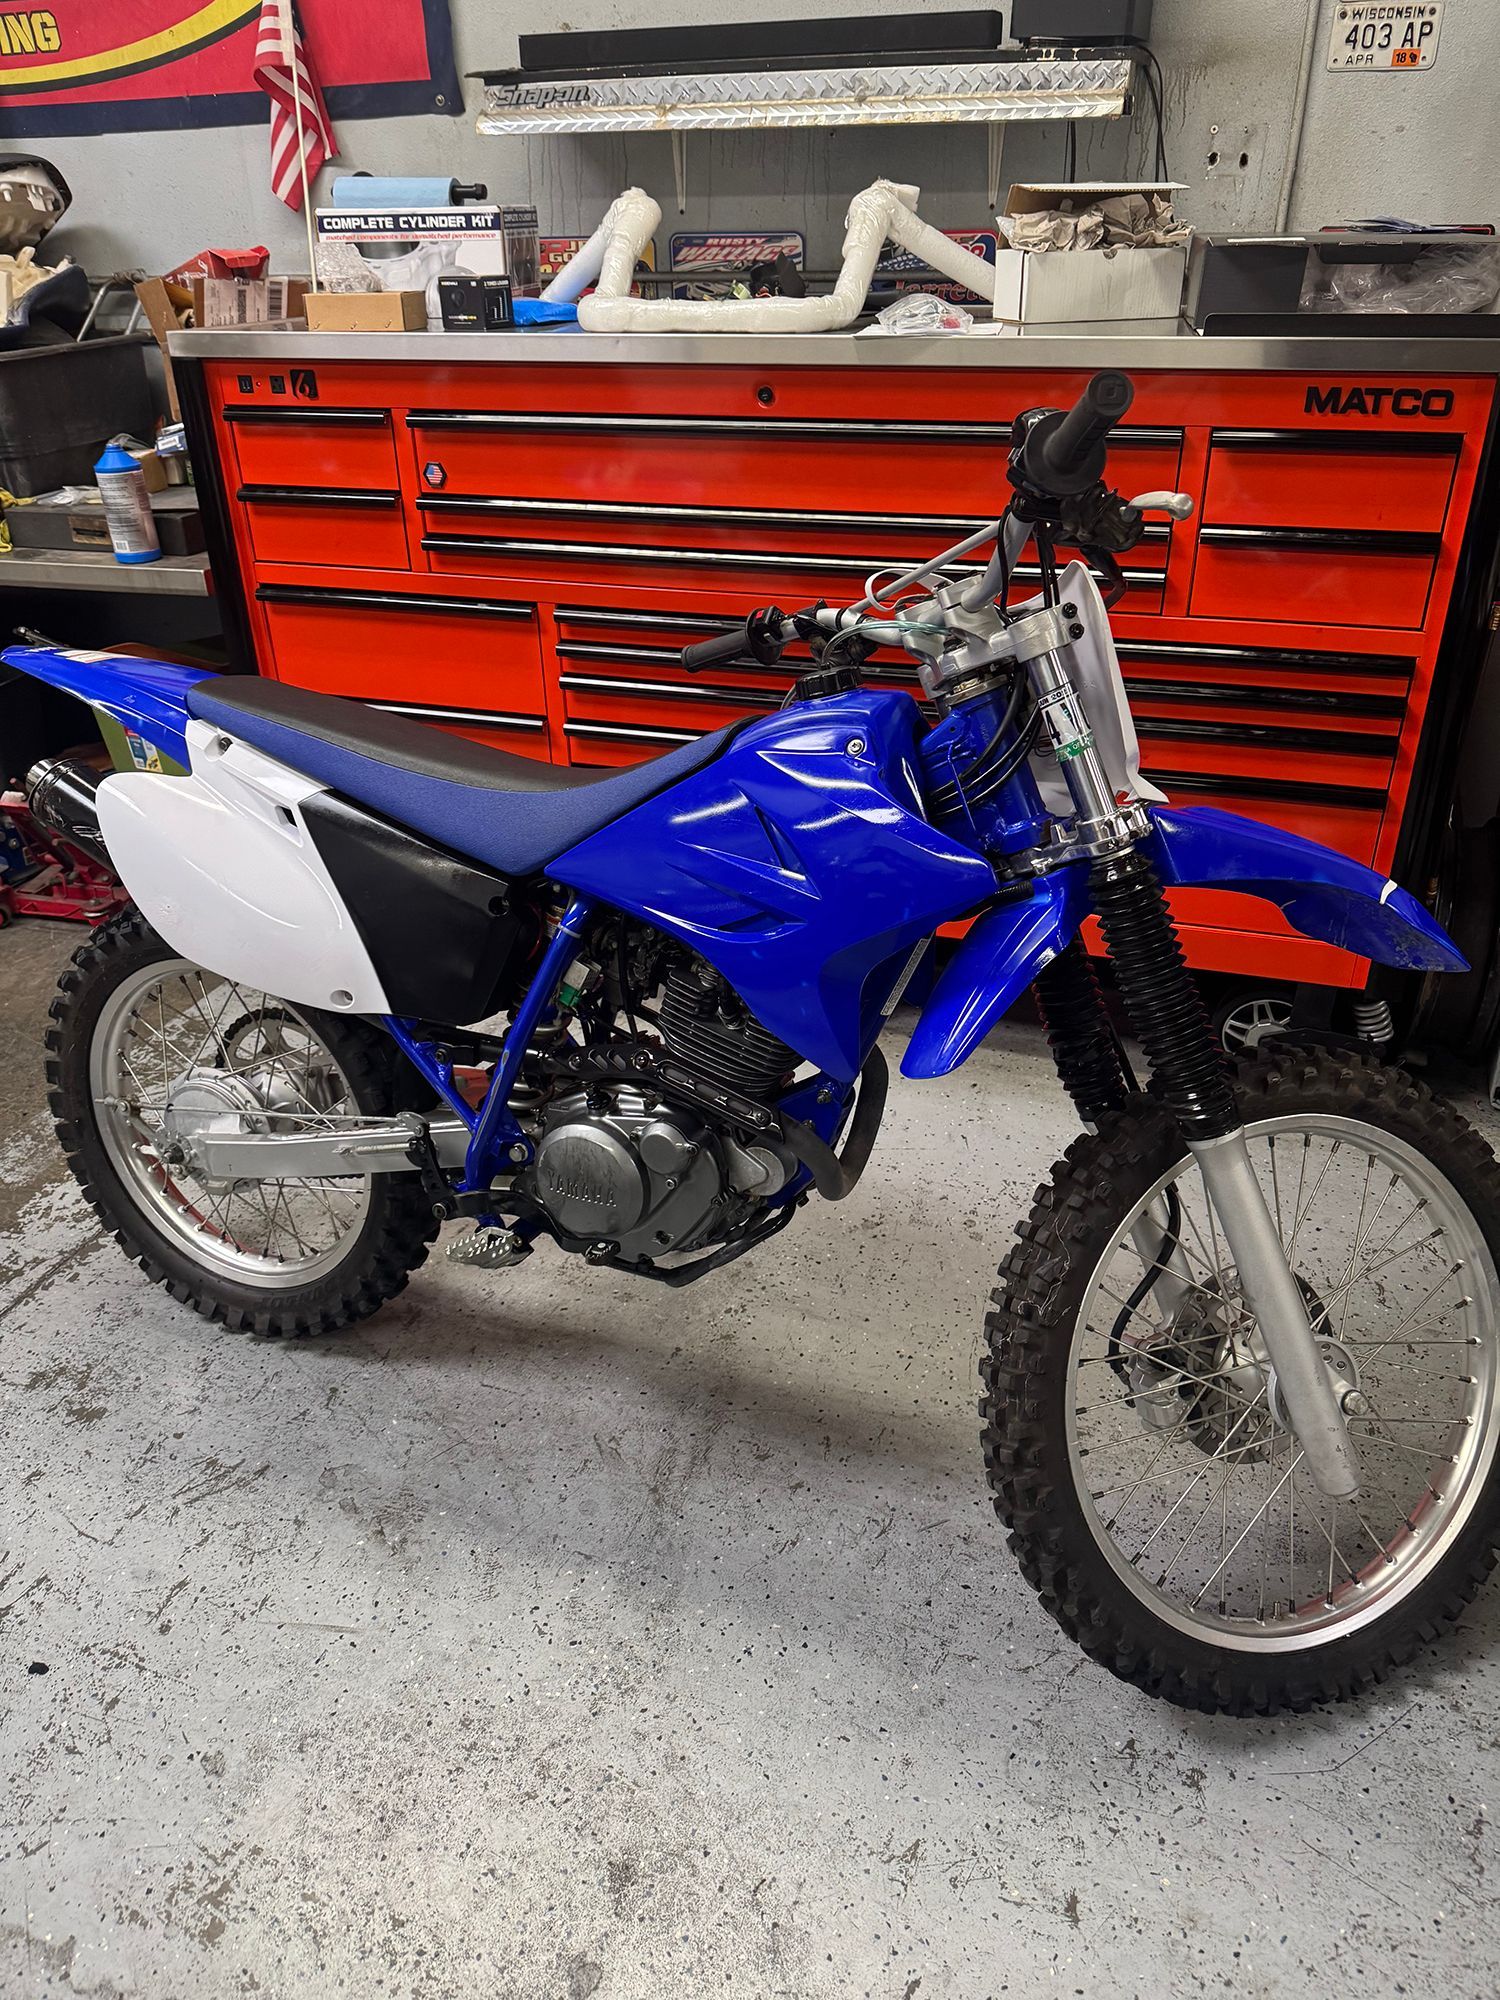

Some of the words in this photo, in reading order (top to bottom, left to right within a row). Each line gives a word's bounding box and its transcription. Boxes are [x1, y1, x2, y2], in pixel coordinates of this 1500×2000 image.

[1352, 6, 1426, 20] WISCONSIN
[1345, 23, 1393, 50] 403
[1401, 21, 1434, 48] AP
[1345, 53, 1374, 65] APR
[1395, 52, 1407, 63] 18
[323, 217, 394, 230] COMPLETE
[399, 215, 466, 229] CYLINDER
[471, 215, 494, 228] KIT
[1303, 386, 1455, 417] MATCO
[547, 1168, 617, 1208] YAMAHA
